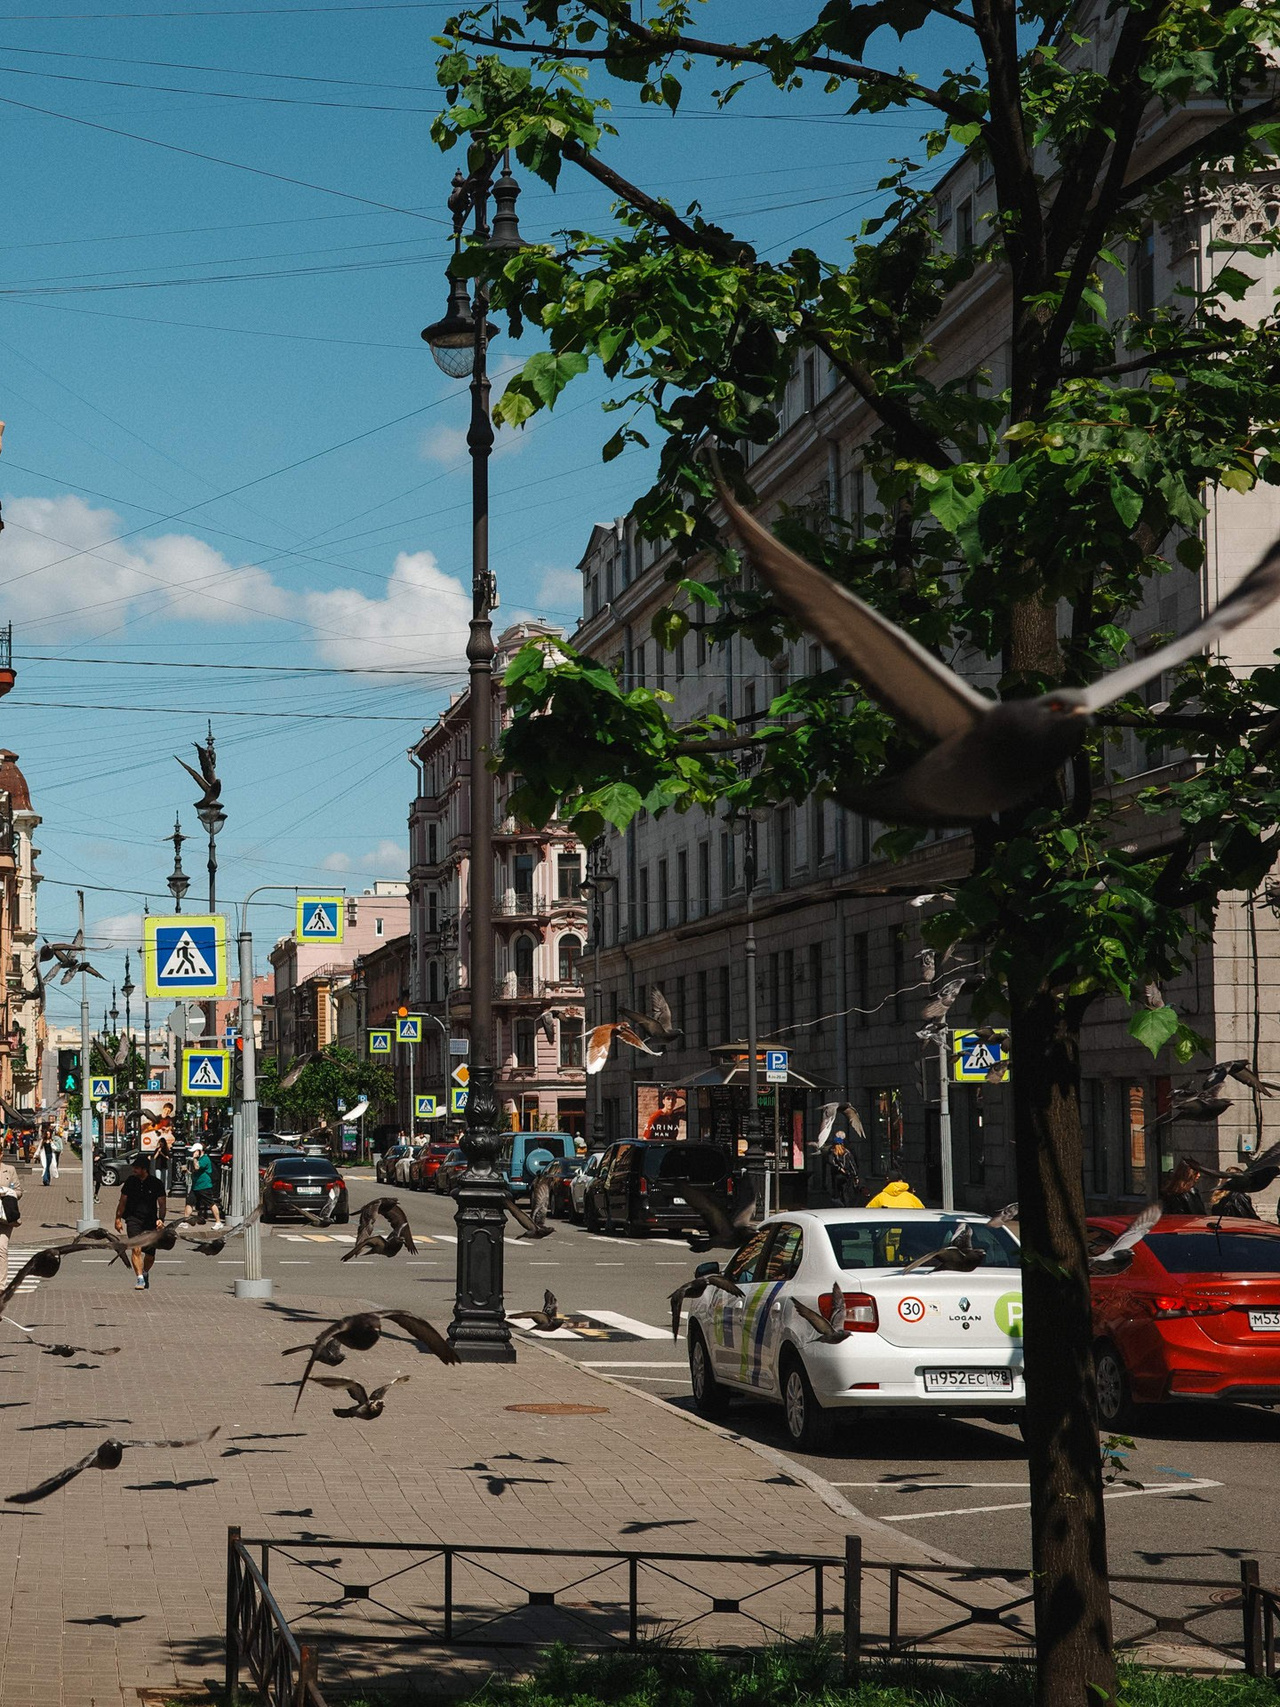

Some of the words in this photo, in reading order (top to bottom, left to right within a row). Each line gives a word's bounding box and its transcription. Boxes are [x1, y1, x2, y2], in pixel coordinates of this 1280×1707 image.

[772, 1053, 784, 1069] P
[903, 1302, 921, 1316] 30
[987, 1370, 1008, 1382] 198
